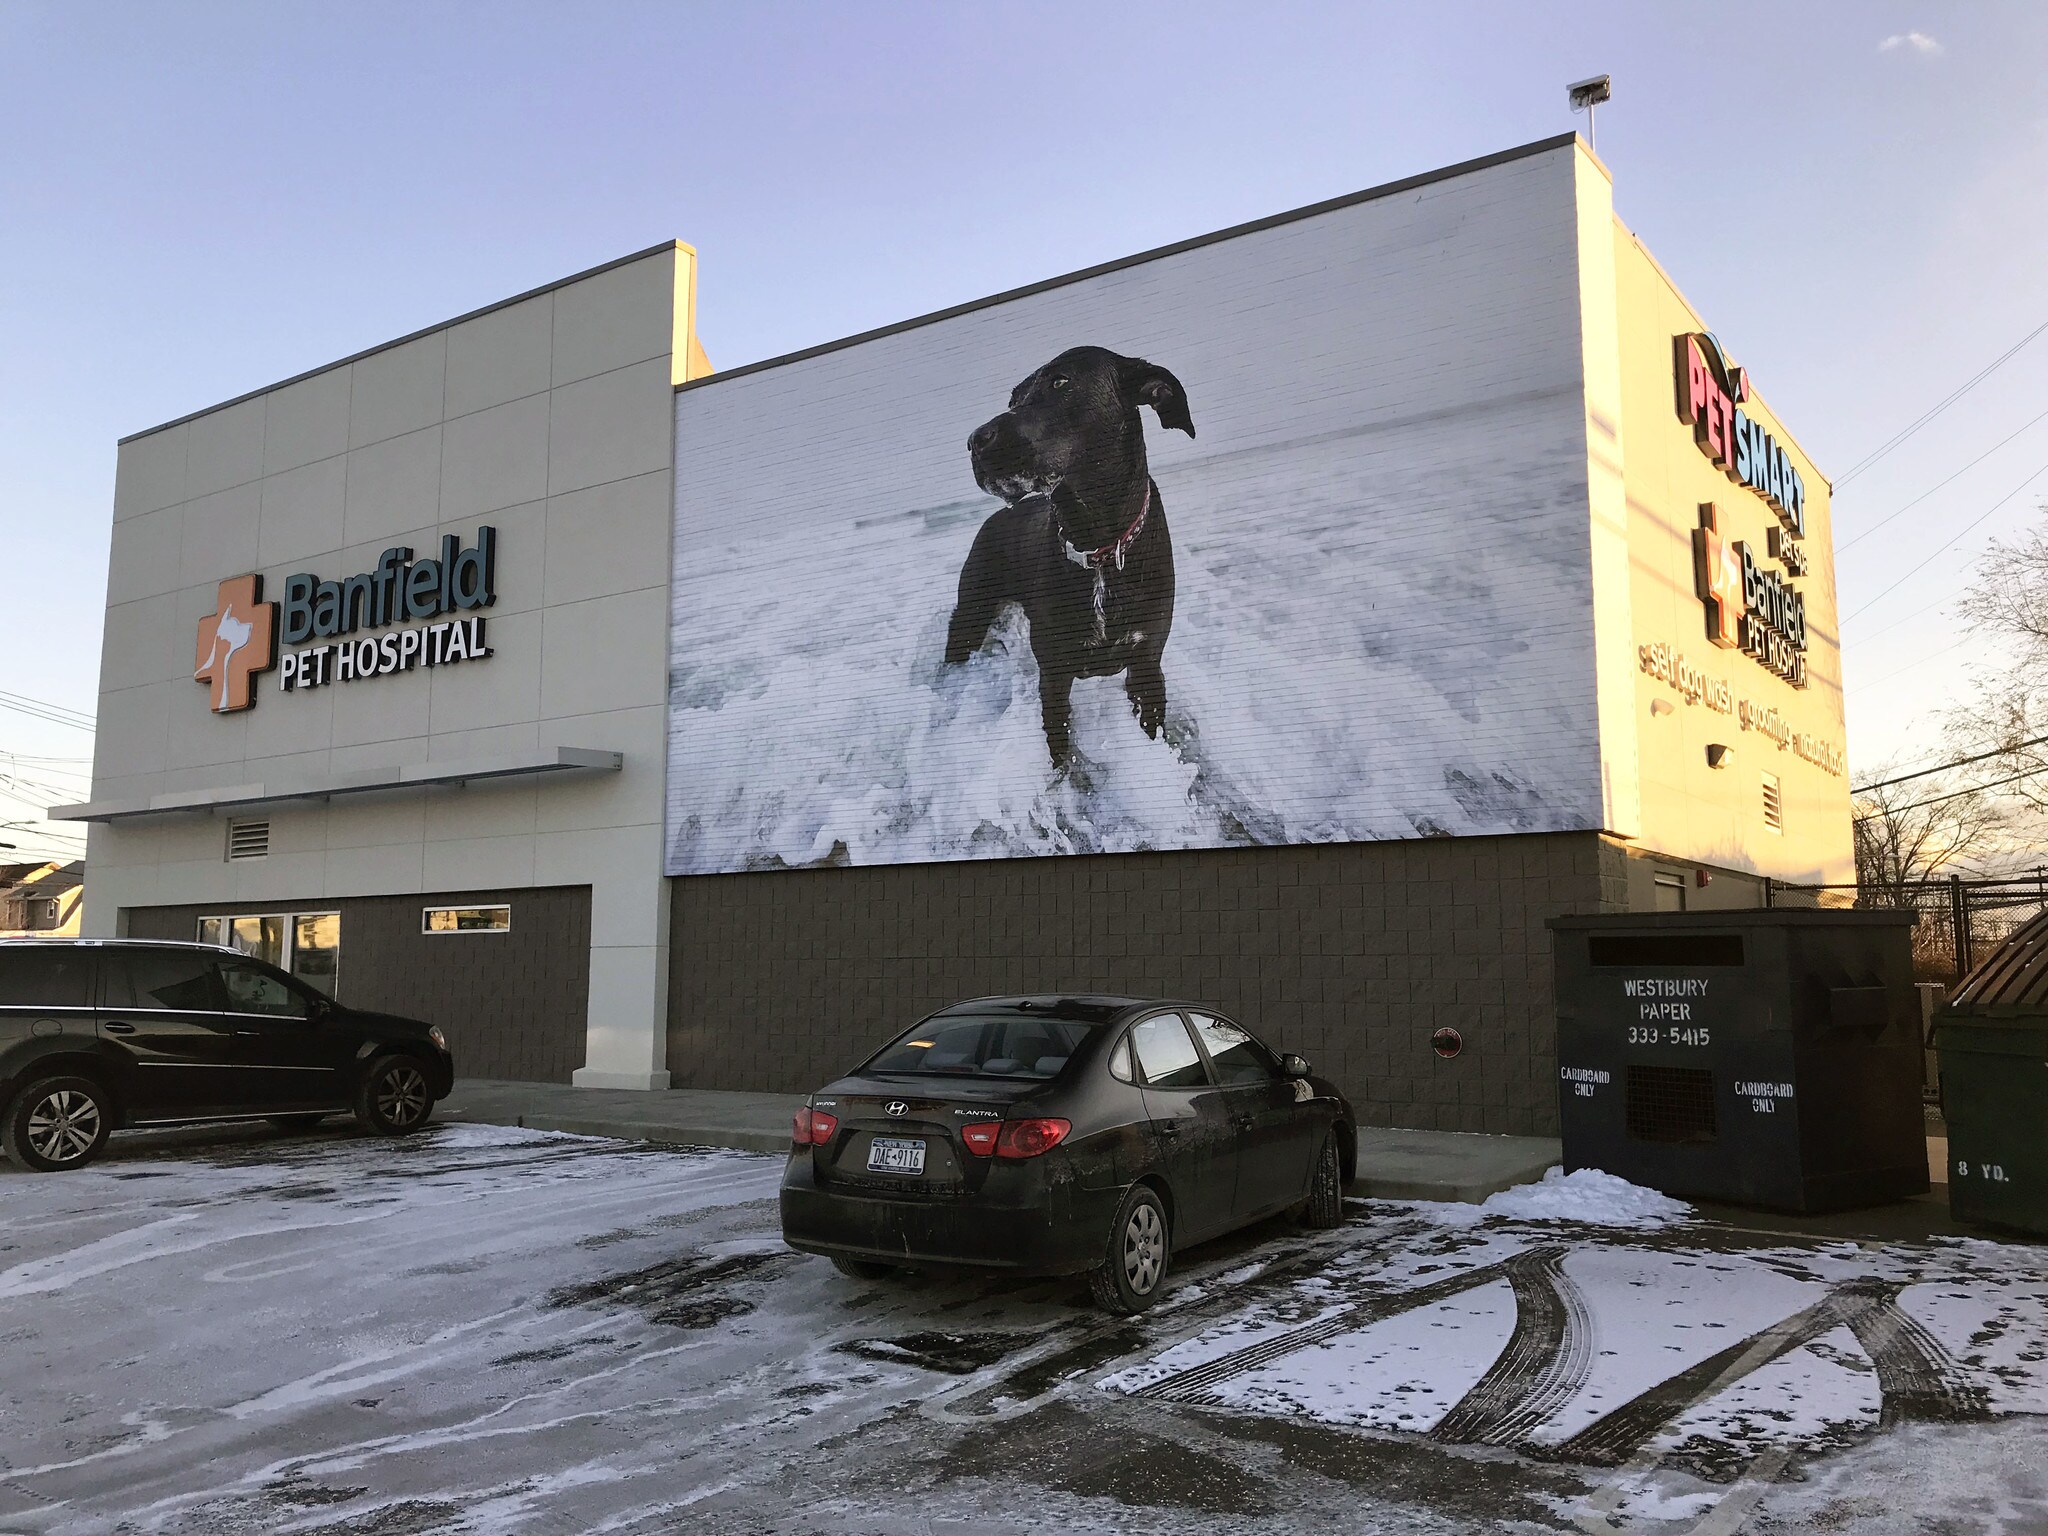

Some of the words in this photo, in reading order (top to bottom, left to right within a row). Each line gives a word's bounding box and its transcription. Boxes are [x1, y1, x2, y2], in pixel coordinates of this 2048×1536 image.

[1685, 334, 1805, 541] PETSMART
[282, 526, 496, 645] Banfield
[1743, 540, 1808, 651] Banfield
[1747, 613, 1766, 662] PET
[280, 646, 336, 691] PET
[336, 616, 493, 682] HOSPITAL
[1678, 654, 1704, 706] dog
[1706, 676, 1735, 715] wash
[1745, 698, 1793, 751] grooming
[1624, 978, 1710, 997] WESTBURY
[1640, 1003, 1691, 1021] PAPER
[1560, 1066, 1610, 1085] CARDBOARD
[1574, 1082, 1595, 1097] ONLY
[1734, 1081, 1794, 1098] CARDBOARD
[954, 1109, 999, 1118] ELANTRA
[1752, 1098, 1776, 1113] ONLY
[873, 1147, 893, 1165] DAE
[896, 1149, 920, 1168] 9116
[1958, 1160, 1969, 1176] 8
